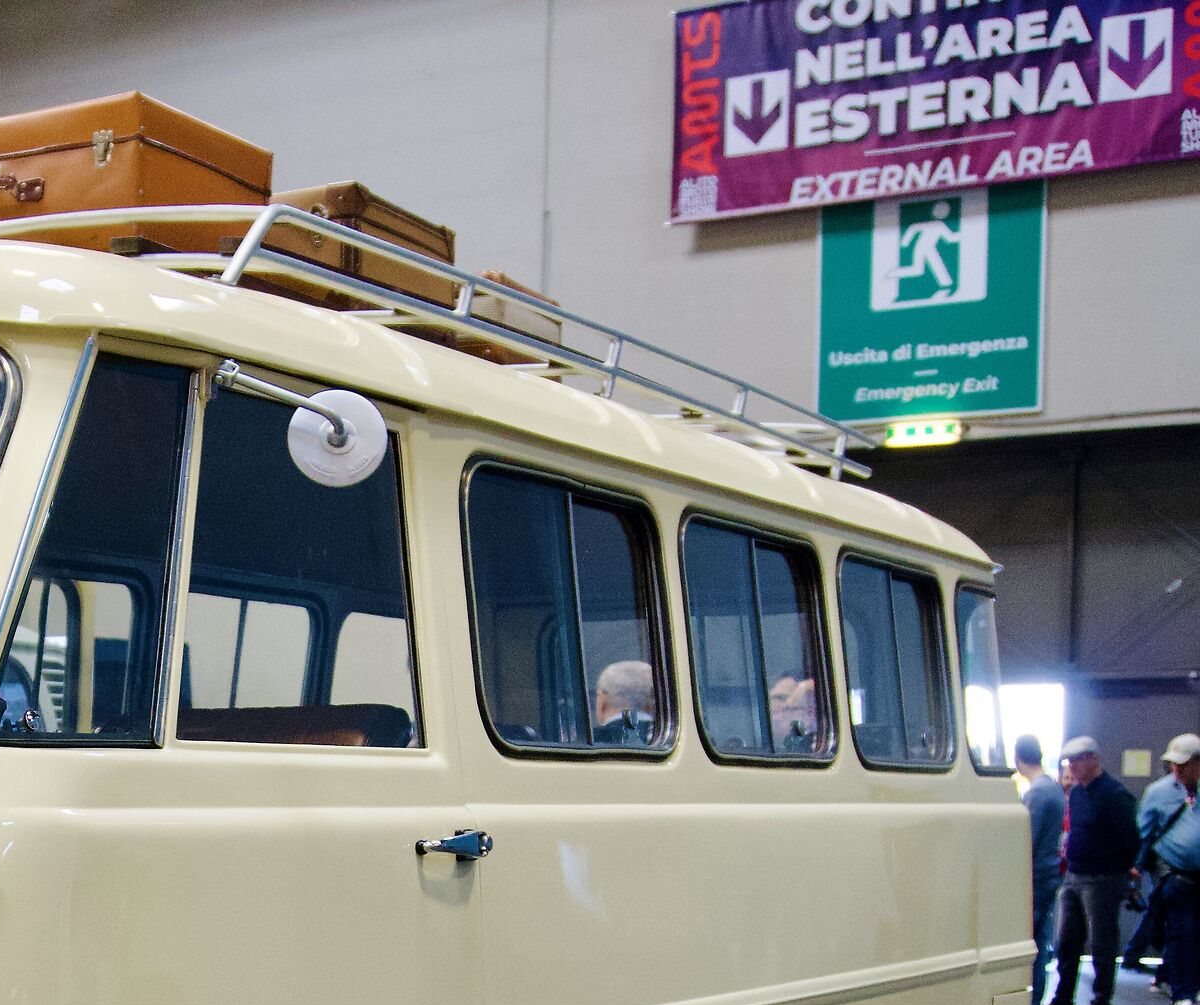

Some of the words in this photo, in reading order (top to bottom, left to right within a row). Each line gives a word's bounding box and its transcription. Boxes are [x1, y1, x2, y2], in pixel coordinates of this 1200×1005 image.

[795, 5, 1093, 89] NELL'AREA
[794, 60, 1093, 148] ESTERNA
[790, 153, 979, 206] EXTERNAL
[985, 138, 1094, 181] AREA
[828, 347, 888, 368] Uscita
[892, 344, 912, 361] di
[916, 336, 1029, 359] Emergenza
[855, 381, 960, 403] Emergency
[962, 374, 999, 393] Exit
